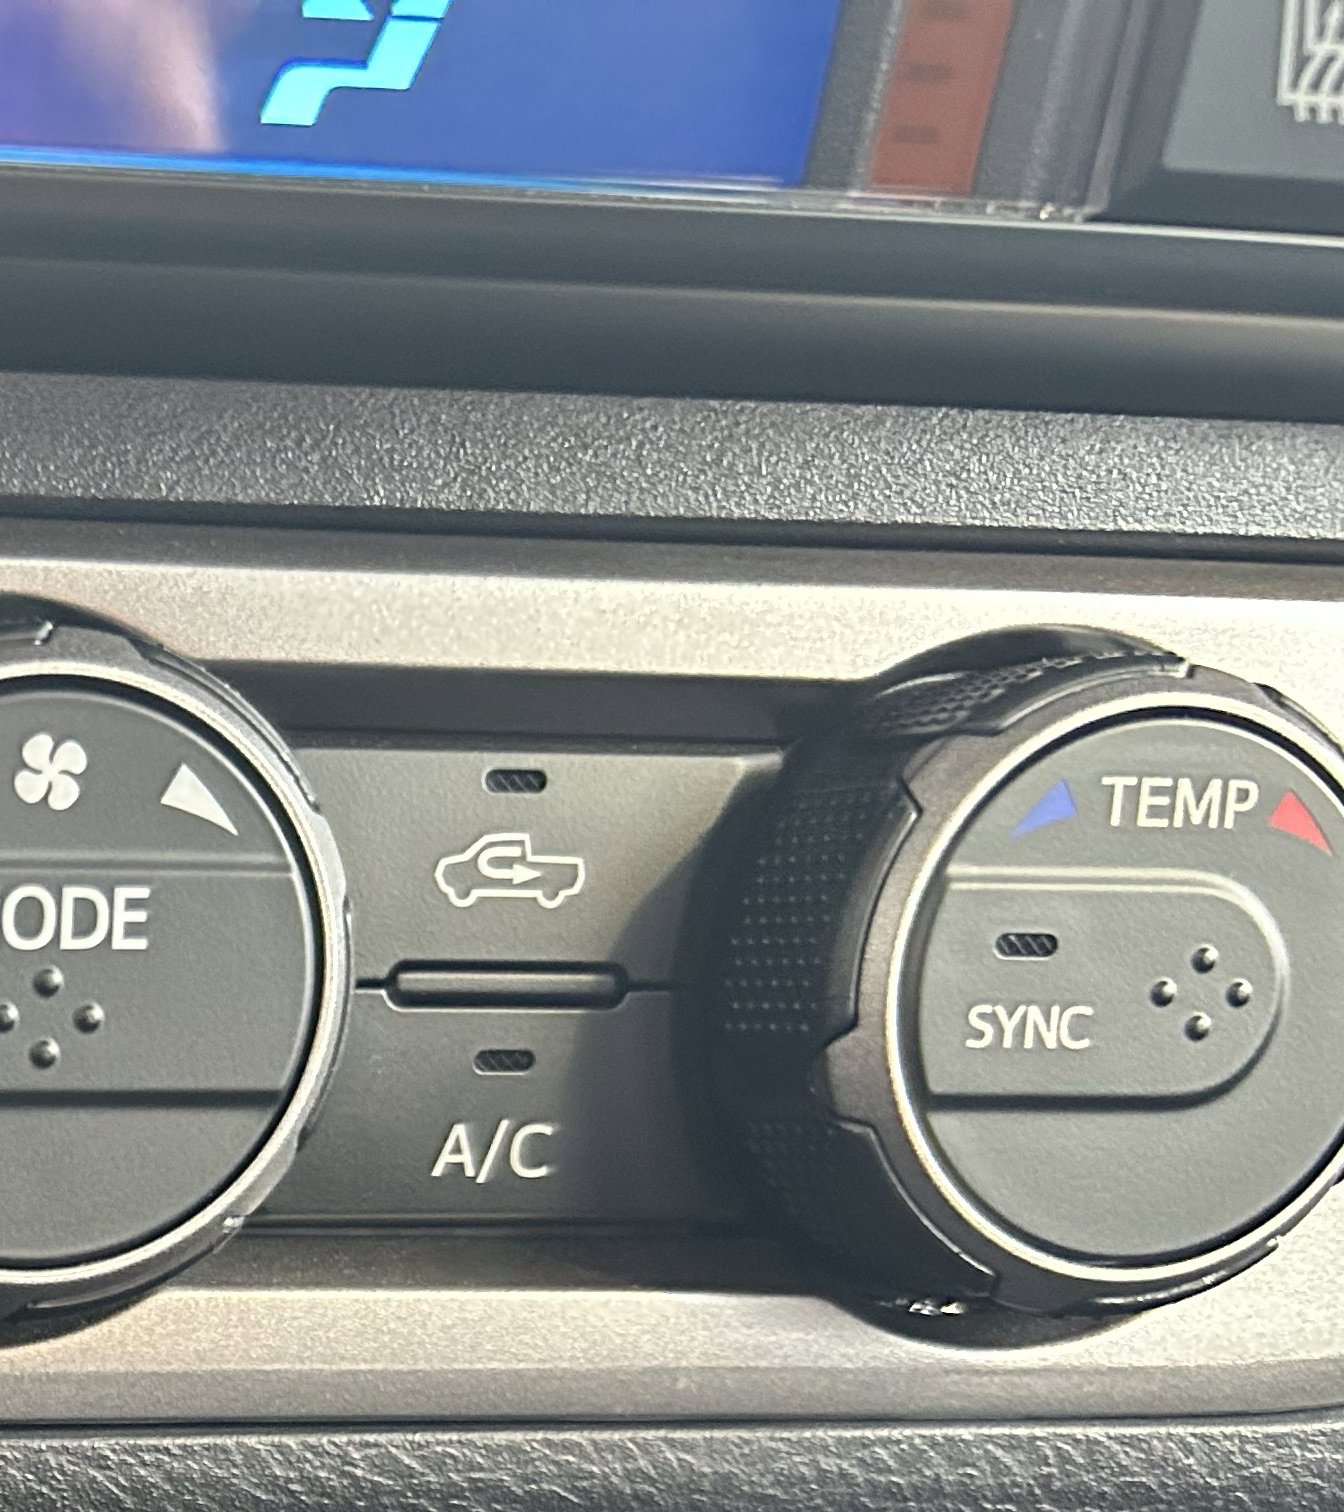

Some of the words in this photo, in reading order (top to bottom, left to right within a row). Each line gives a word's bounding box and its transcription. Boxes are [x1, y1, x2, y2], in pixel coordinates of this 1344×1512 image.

[1102, 775, 1260, 830] TEMP
[965, 1004, 1094, 1050] SYNC
[430, 1118, 555, 1184] A/C
